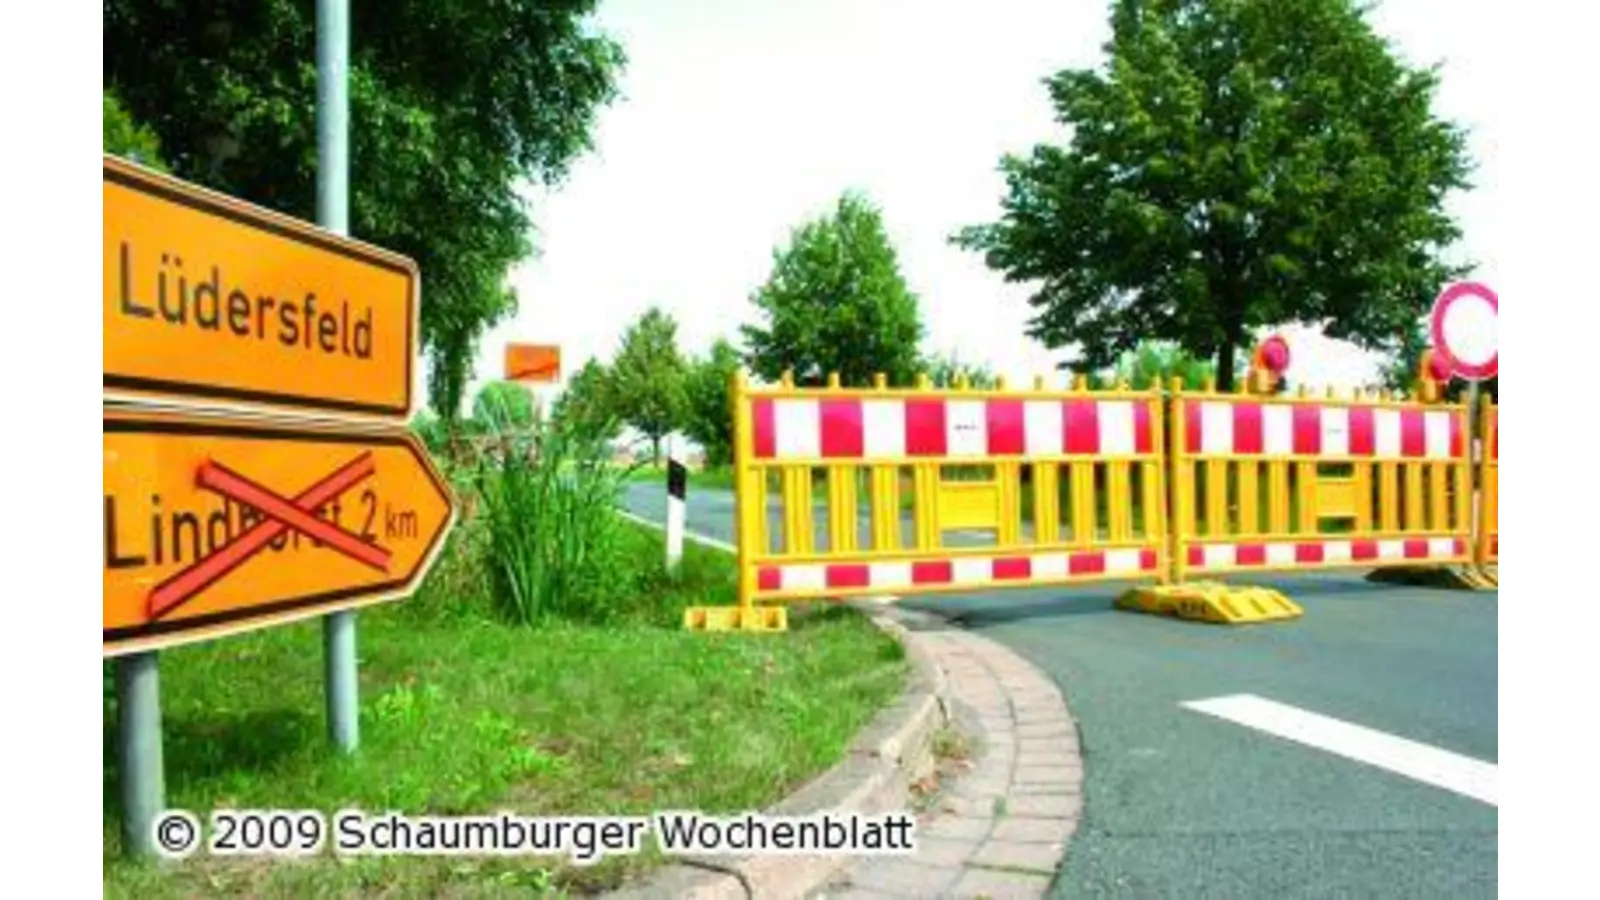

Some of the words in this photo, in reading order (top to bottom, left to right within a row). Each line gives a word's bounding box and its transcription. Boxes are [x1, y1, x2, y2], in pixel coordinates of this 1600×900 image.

[119, 241, 374, 360] Lüdersfeld
[360, 488, 378, 543] 2
[384, 502, 419, 539] km
